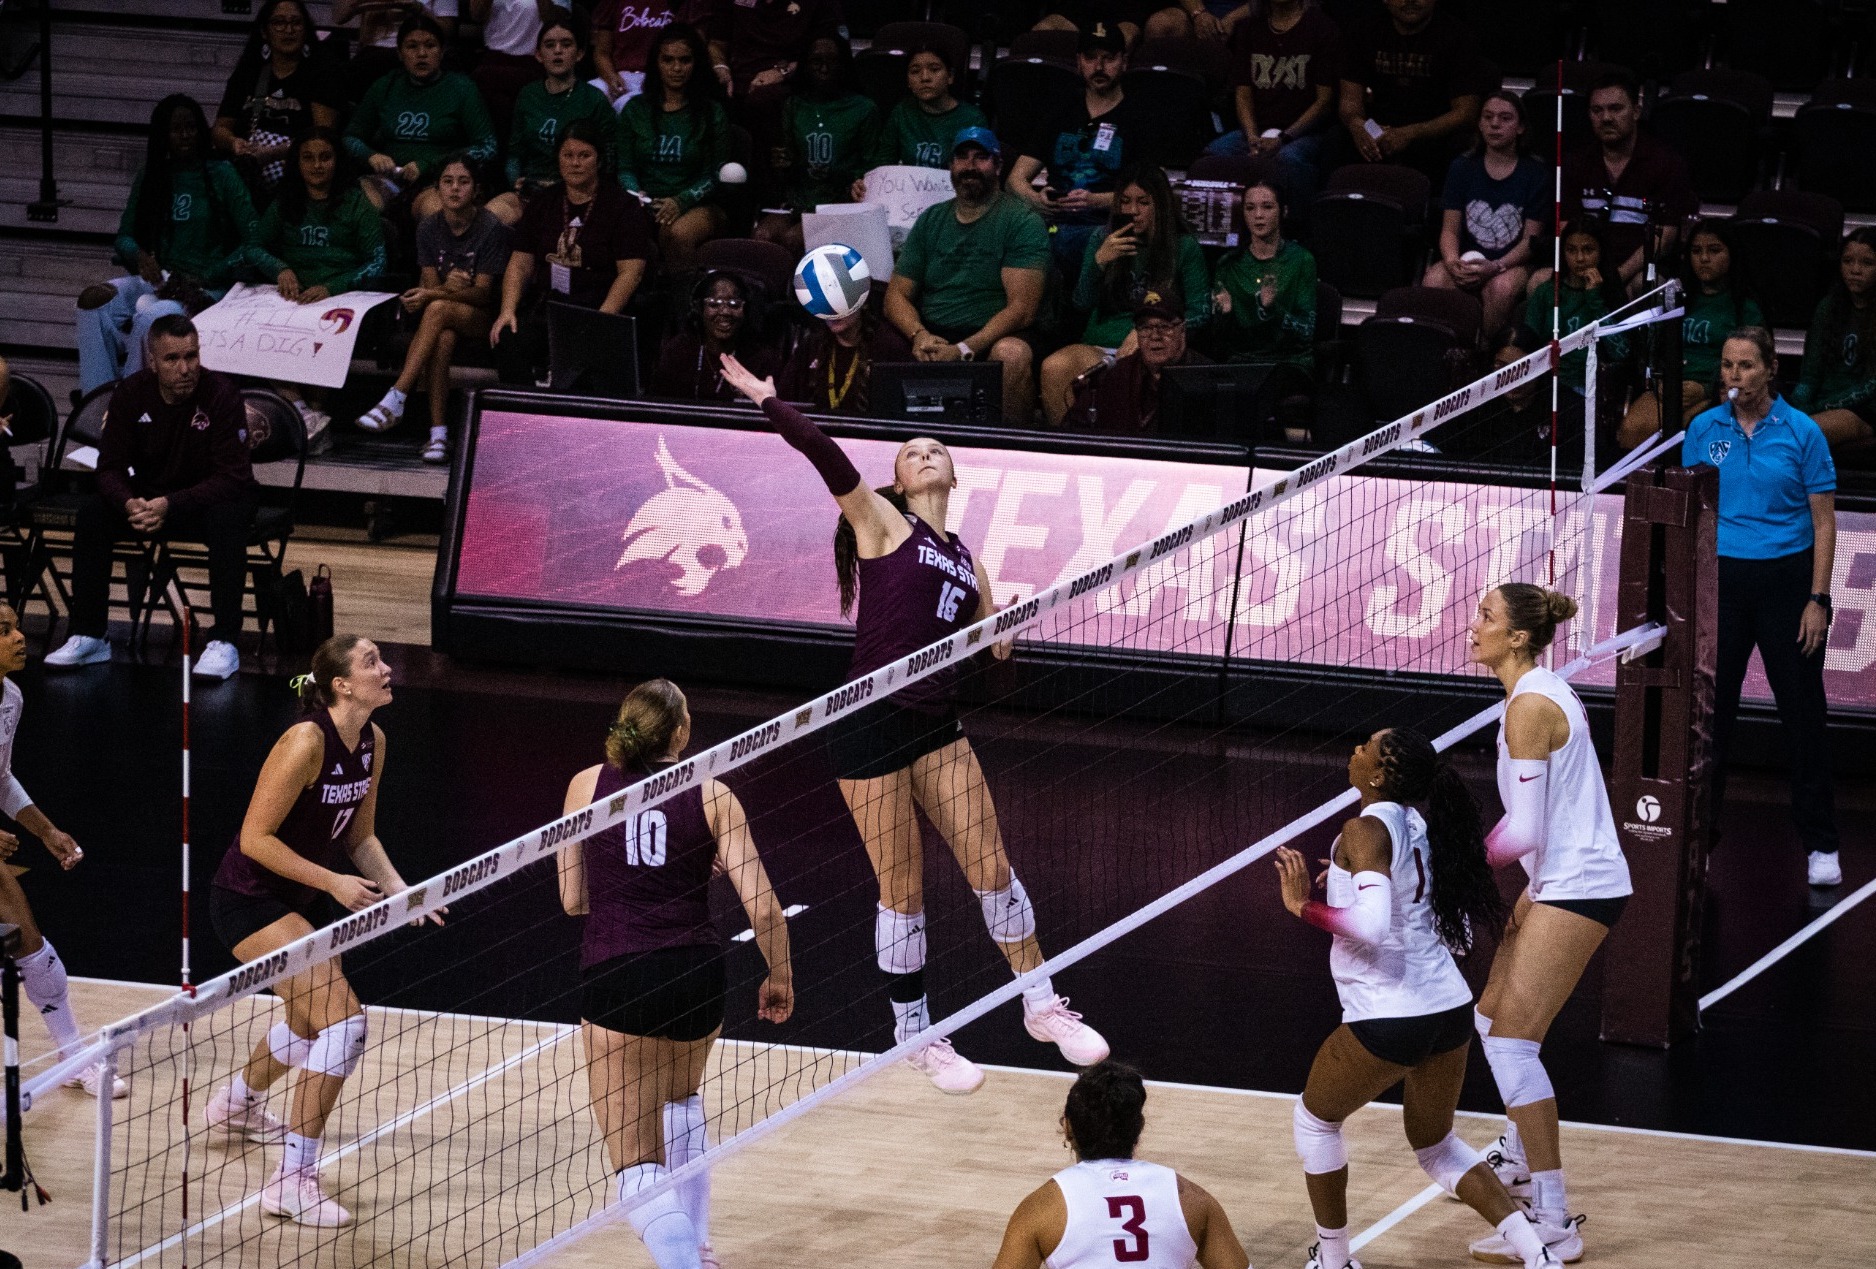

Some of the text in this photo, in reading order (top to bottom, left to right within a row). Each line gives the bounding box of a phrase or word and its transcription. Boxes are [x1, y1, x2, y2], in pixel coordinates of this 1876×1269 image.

[395, 111, 431, 141] 22
[539, 118, 557, 145] 4
[805, 132, 833, 164] 10
[169, 193, 192, 221] 2
[918, 545, 957, 577] TEXAS
[957, 564, 979, 592] STA
[1364, 499, 1624, 652] STA
[936, 580, 967, 623] 16
[226, 950, 289, 998] BOBCATS
[330, 903, 390, 950] BOBCATS
[442, 852, 500, 898] BOBCATS
[538, 808, 594, 852] BOBCATS
[641, 761, 695, 804] BOBCATS
[729, 720, 781, 763] BOBCATS
[825, 676, 875, 717] BOBCATS
[906, 639, 954, 678] BOBCATS
[993, 598, 1040, 636] BOBCATS
[1068, 563, 1114, 600] BOBCATS
[1149, 523, 1194, 560] BOBCATS
[1220, 490, 1263, 525] BOBCATS
[1296, 454, 1338, 488] BOBCATS
[1361, 423, 1402, 456] BOBCATS
[1433, 388, 1471, 421] BOBCATS
[1494, 358, 1531, 391] BOBCATS
[321, 783, 353, 804] TEXAS
[331, 807, 355, 840] 17
[625, 809, 668, 867] 10
[1623, 821, 1646, 831] SPORTS
[1646, 825, 1672, 836] IMPORTS
[1103, 1195, 1150, 1263] 3
